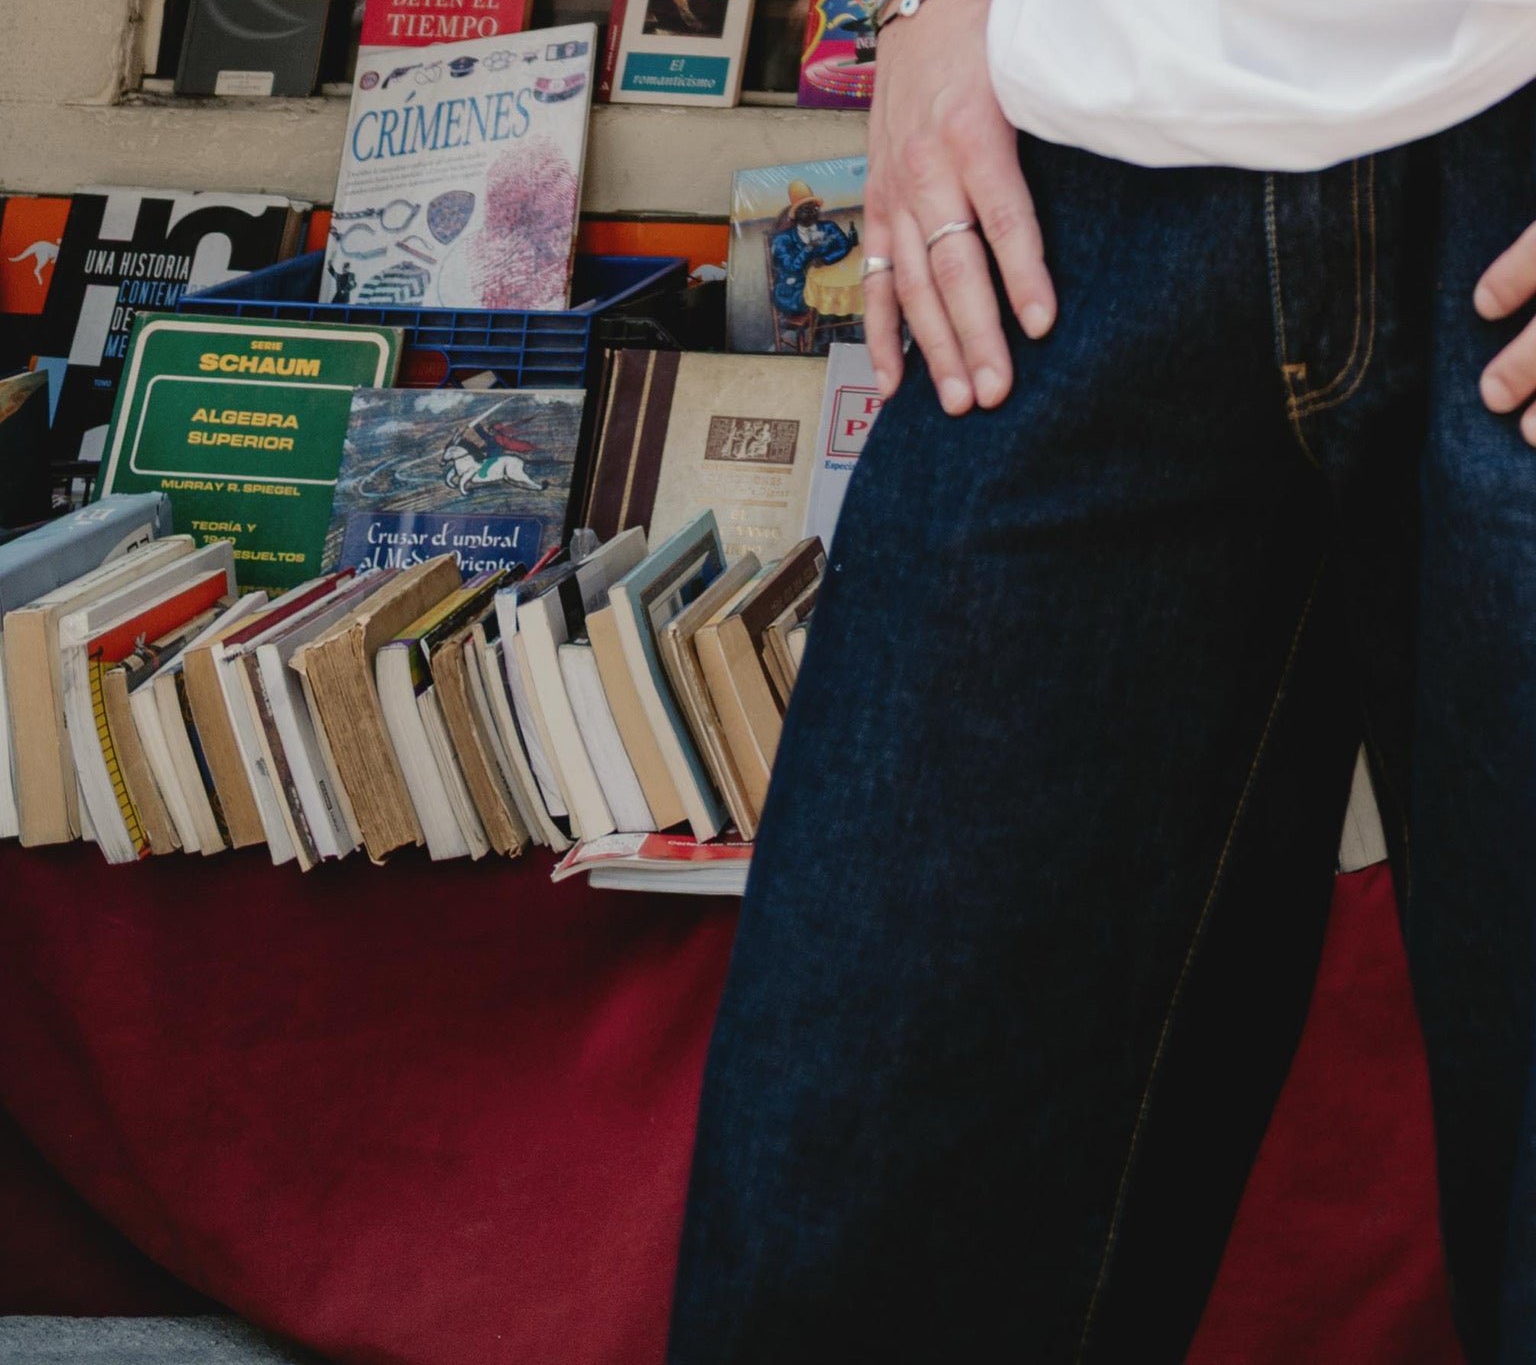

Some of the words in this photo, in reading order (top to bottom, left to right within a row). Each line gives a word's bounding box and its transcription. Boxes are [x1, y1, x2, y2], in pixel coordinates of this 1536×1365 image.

[386, 13, 499, 39] TIEMPO
[668, 58, 686, 71] El
[632, 72, 717, 89] romanticismo
[352, 87, 532, 163] CRÍMENES
[84, 249, 114, 275] UNA
[118, 252, 191, 280] HISTORIA
[117, 279, 188, 306] CONTEMP
[250, 340, 283, 352] SERIE
[199, 352, 322, 377] SCHAUM
[190, 407, 299, 430] ALGEBRA
[187, 431, 295, 451] SUPERIOR
[161, 478, 224, 492] MURRAY
[227, 482, 241, 493] R.
[242, 482, 301, 497] SPIEGEL
[191, 519, 242, 533] TEORÍA
[247, 522, 258, 533] Y
[431, 522, 450, 546] el
[452, 524, 521, 549] umbral
[232, 549, 305, 564] ESUELTOS
